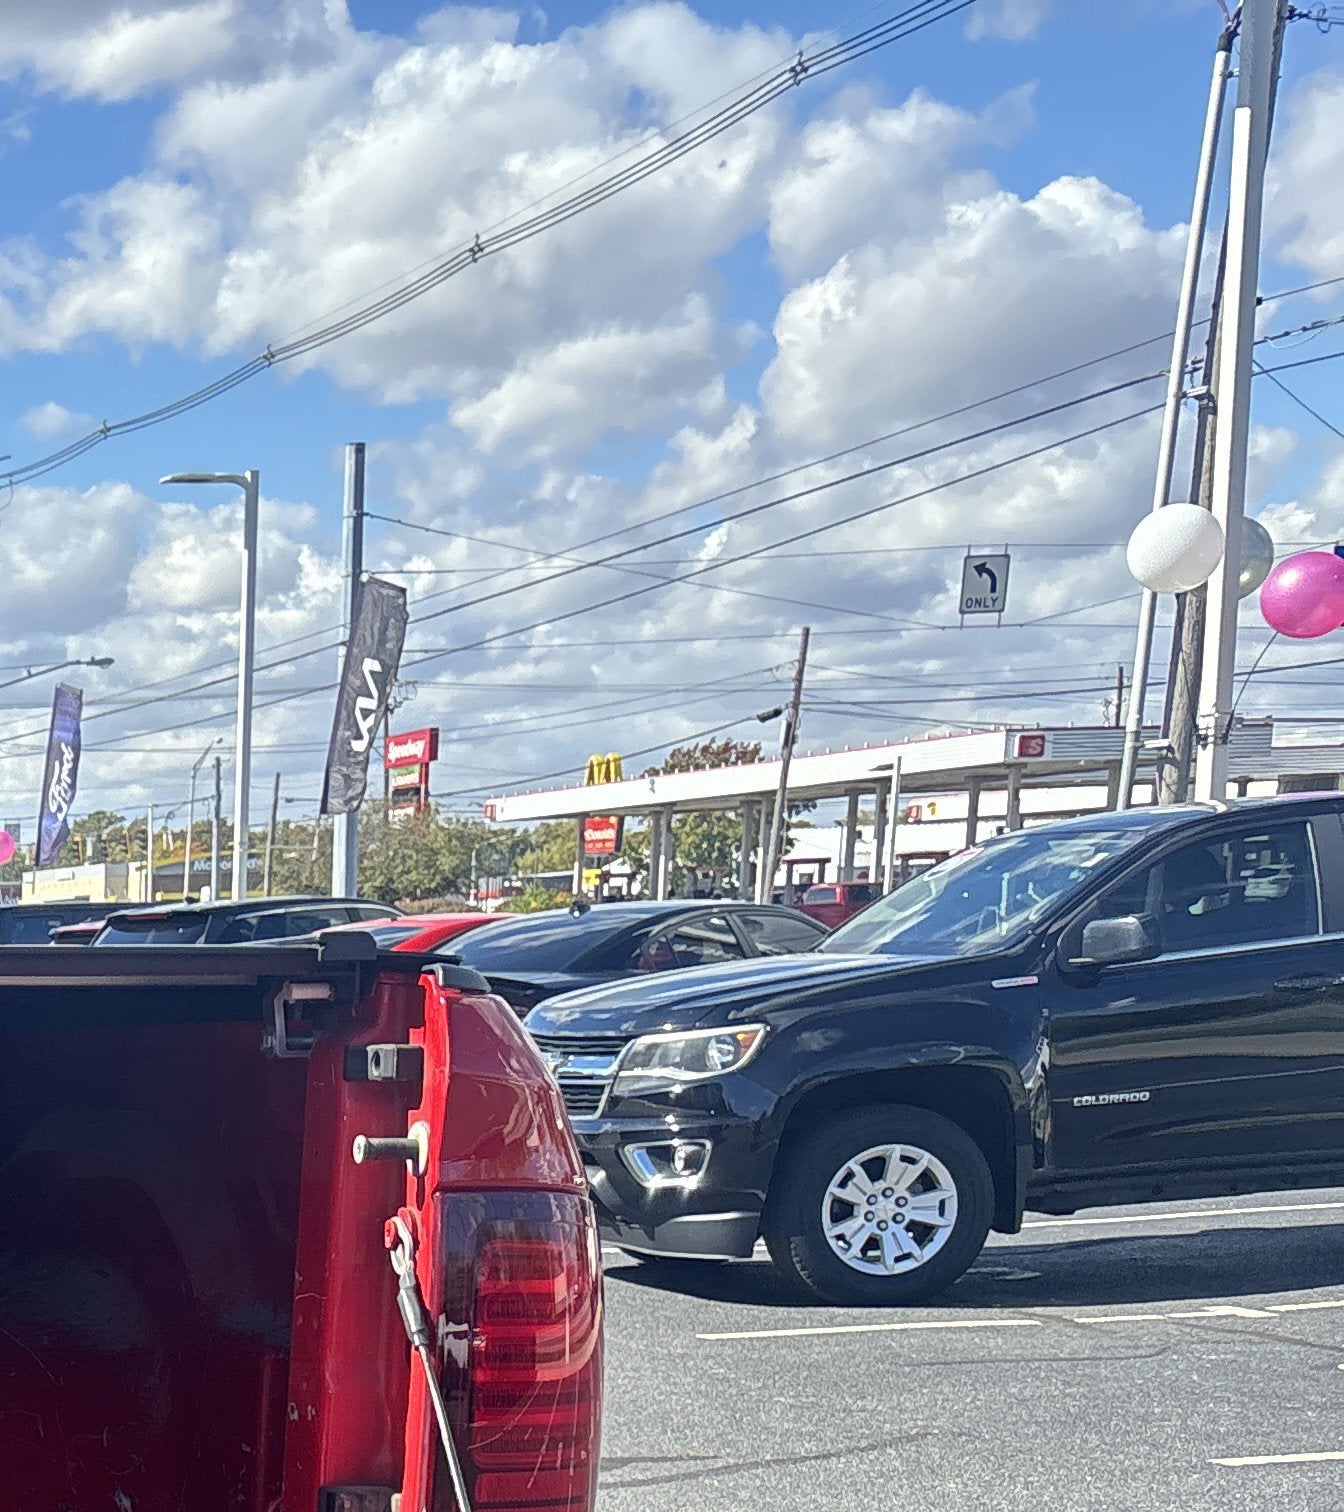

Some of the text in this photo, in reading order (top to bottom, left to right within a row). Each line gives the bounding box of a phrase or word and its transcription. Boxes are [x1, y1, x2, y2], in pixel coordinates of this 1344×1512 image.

[965, 596, 999, 609] ONLY
[48, 741, 75, 822] Ford
[1073, 1091, 1151, 1107] COLORADO
